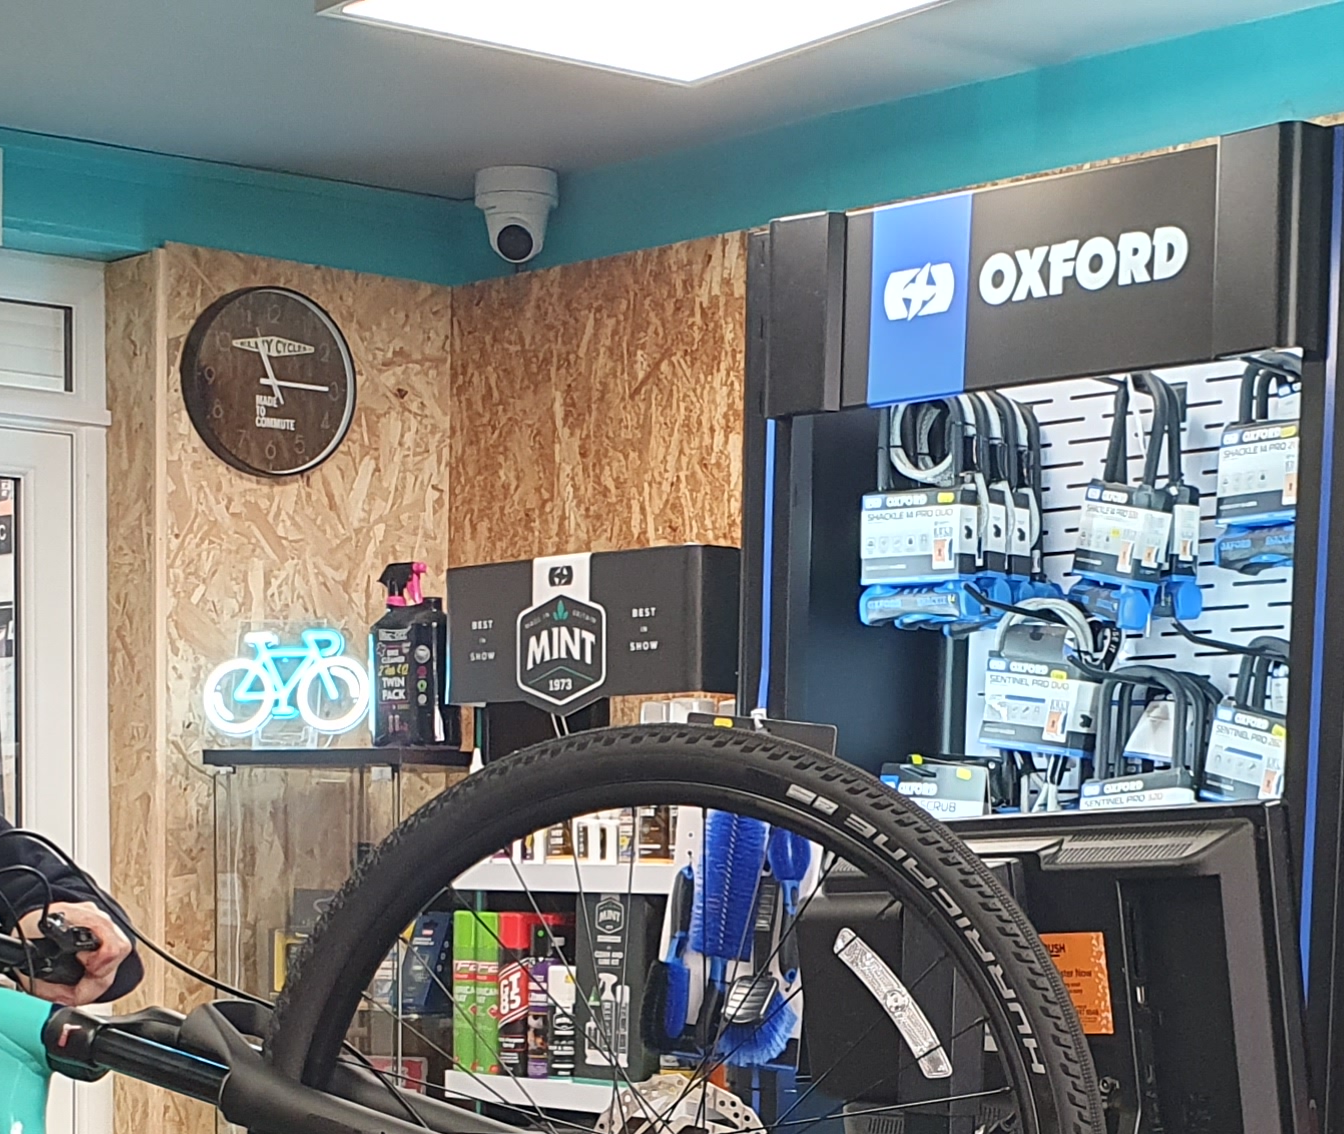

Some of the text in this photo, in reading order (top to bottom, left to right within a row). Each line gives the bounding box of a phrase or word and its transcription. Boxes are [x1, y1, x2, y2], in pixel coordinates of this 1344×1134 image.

[978, 226, 1189, 306] OXFORD
[256, 406, 266, 417] TO
[256, 417, 296, 431] COMMUTE
[1223, 446, 1258, 459] SHACKLE
[1269, 442, 1286, 451] PRO
[886, 494, 927, 507] OXFORD
[867, 511, 904, 521] SHACKLE
[915, 510, 933, 518] PRO
[935, 509, 953, 517] DUO
[632, 607, 656, 617] BEST
[472, 620, 493, 629] BEST
[527, 626, 596, 670] MINT
[630, 641, 658, 651] SHOW
[470, 652, 495, 660] SHOW
[1010, 661, 1048, 675] OXFORD
[382, 677, 405, 687] TWIN
[549, 679, 572, 691] 1973
[989, 675, 1069, 690] SENTINEL PRO DUO
[382, 690, 406, 700] PACK
[898, 783, 937, 796] OXFORD
[1104, 781, 1143, 793] OXFORD
